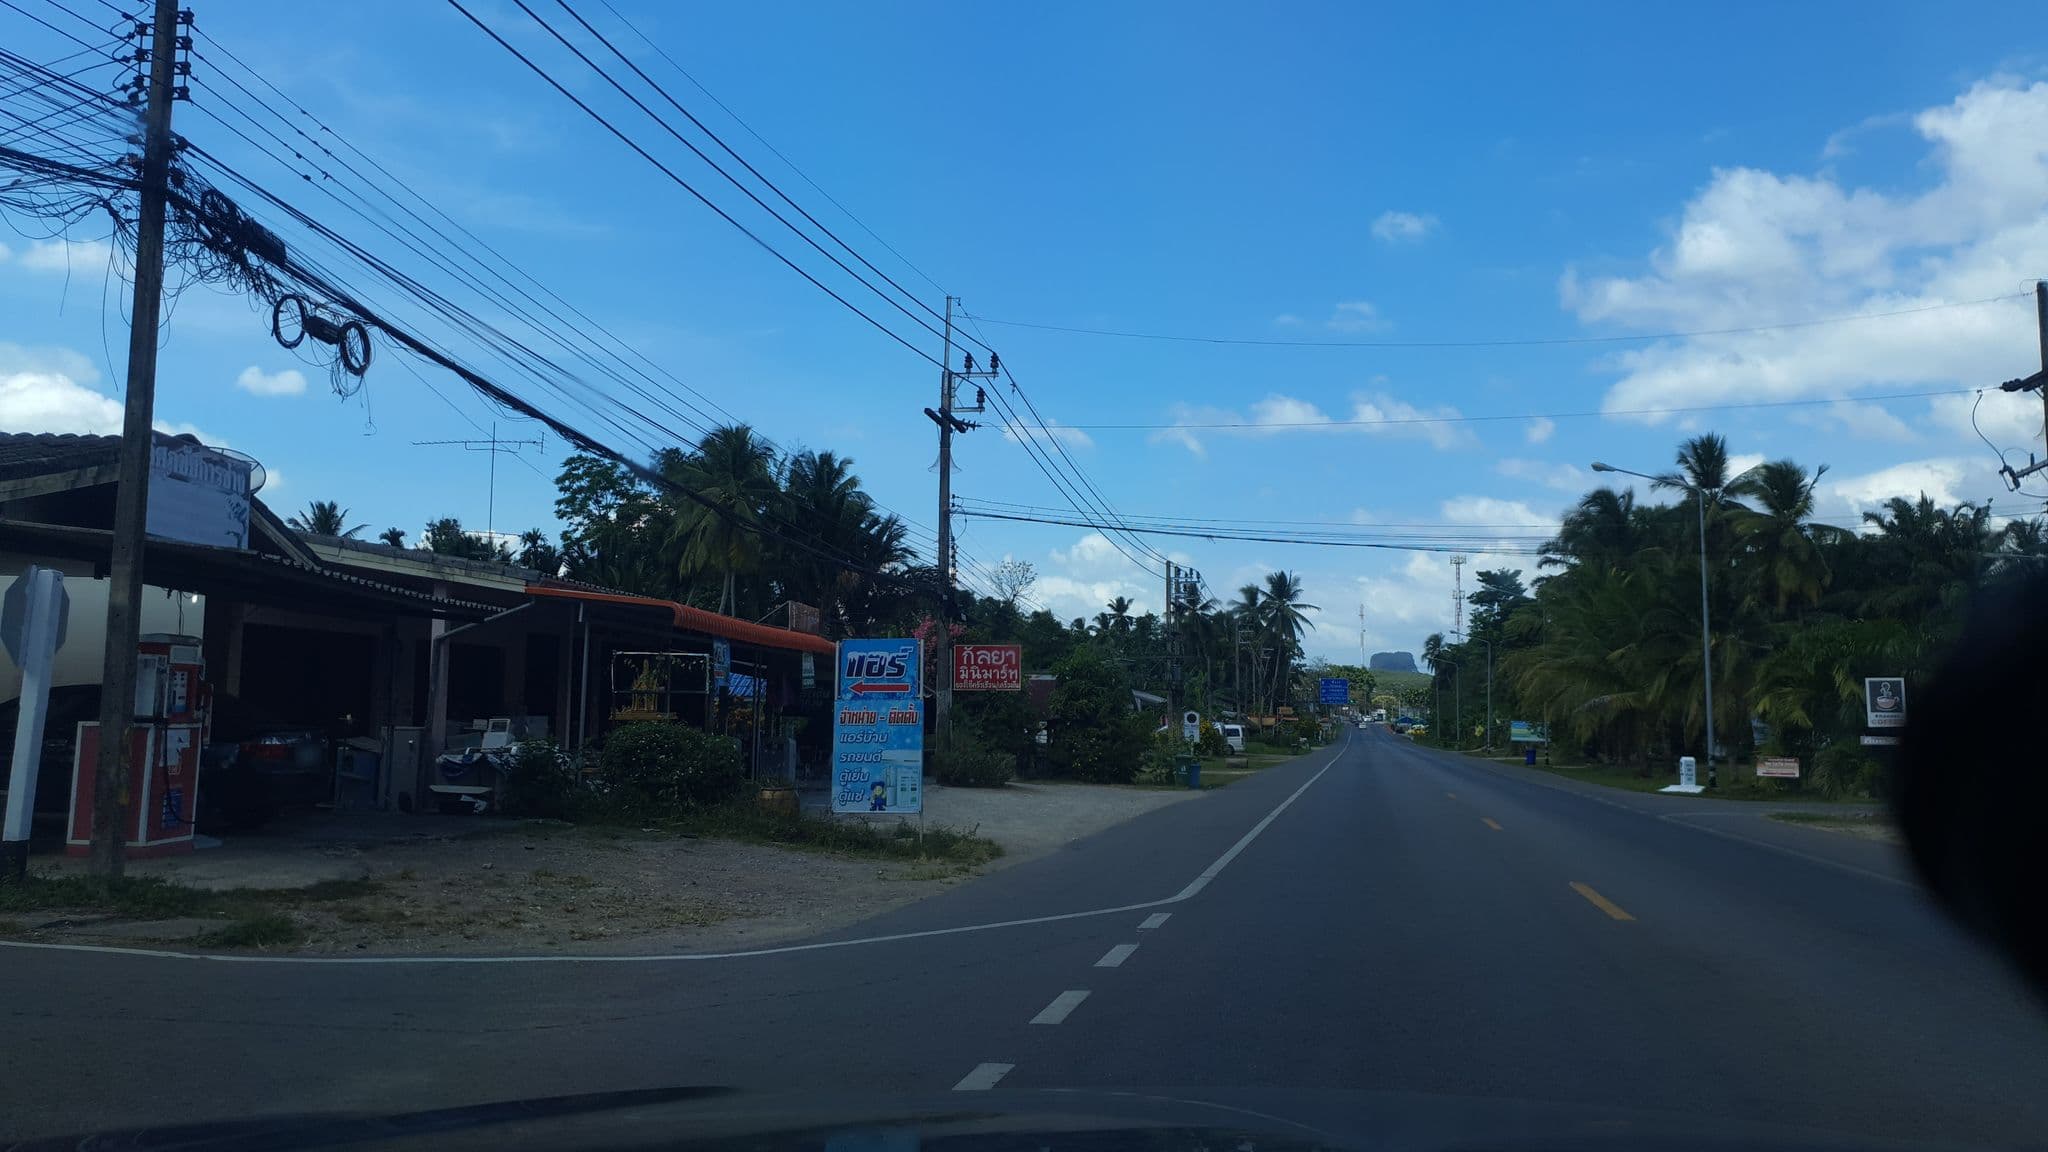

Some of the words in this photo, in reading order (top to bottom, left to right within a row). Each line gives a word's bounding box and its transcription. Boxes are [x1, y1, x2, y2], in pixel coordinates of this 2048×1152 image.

[847, 646, 913, 678] แอร์
[961, 646, 1016, 665] กัลยา
[959, 664, 1018, 680] มินิมาร์ท
[839, 706, 877, 726] จำหน่าย
[887, 704, 919, 726] ติดตั้ง
[839, 730, 888, 745] แอร์บ้าน
[839, 748, 883, 763] รถยนต์
[839, 768, 869, 786] ตู้เย็น
[838, 786, 864, 806] ตู้แช่
